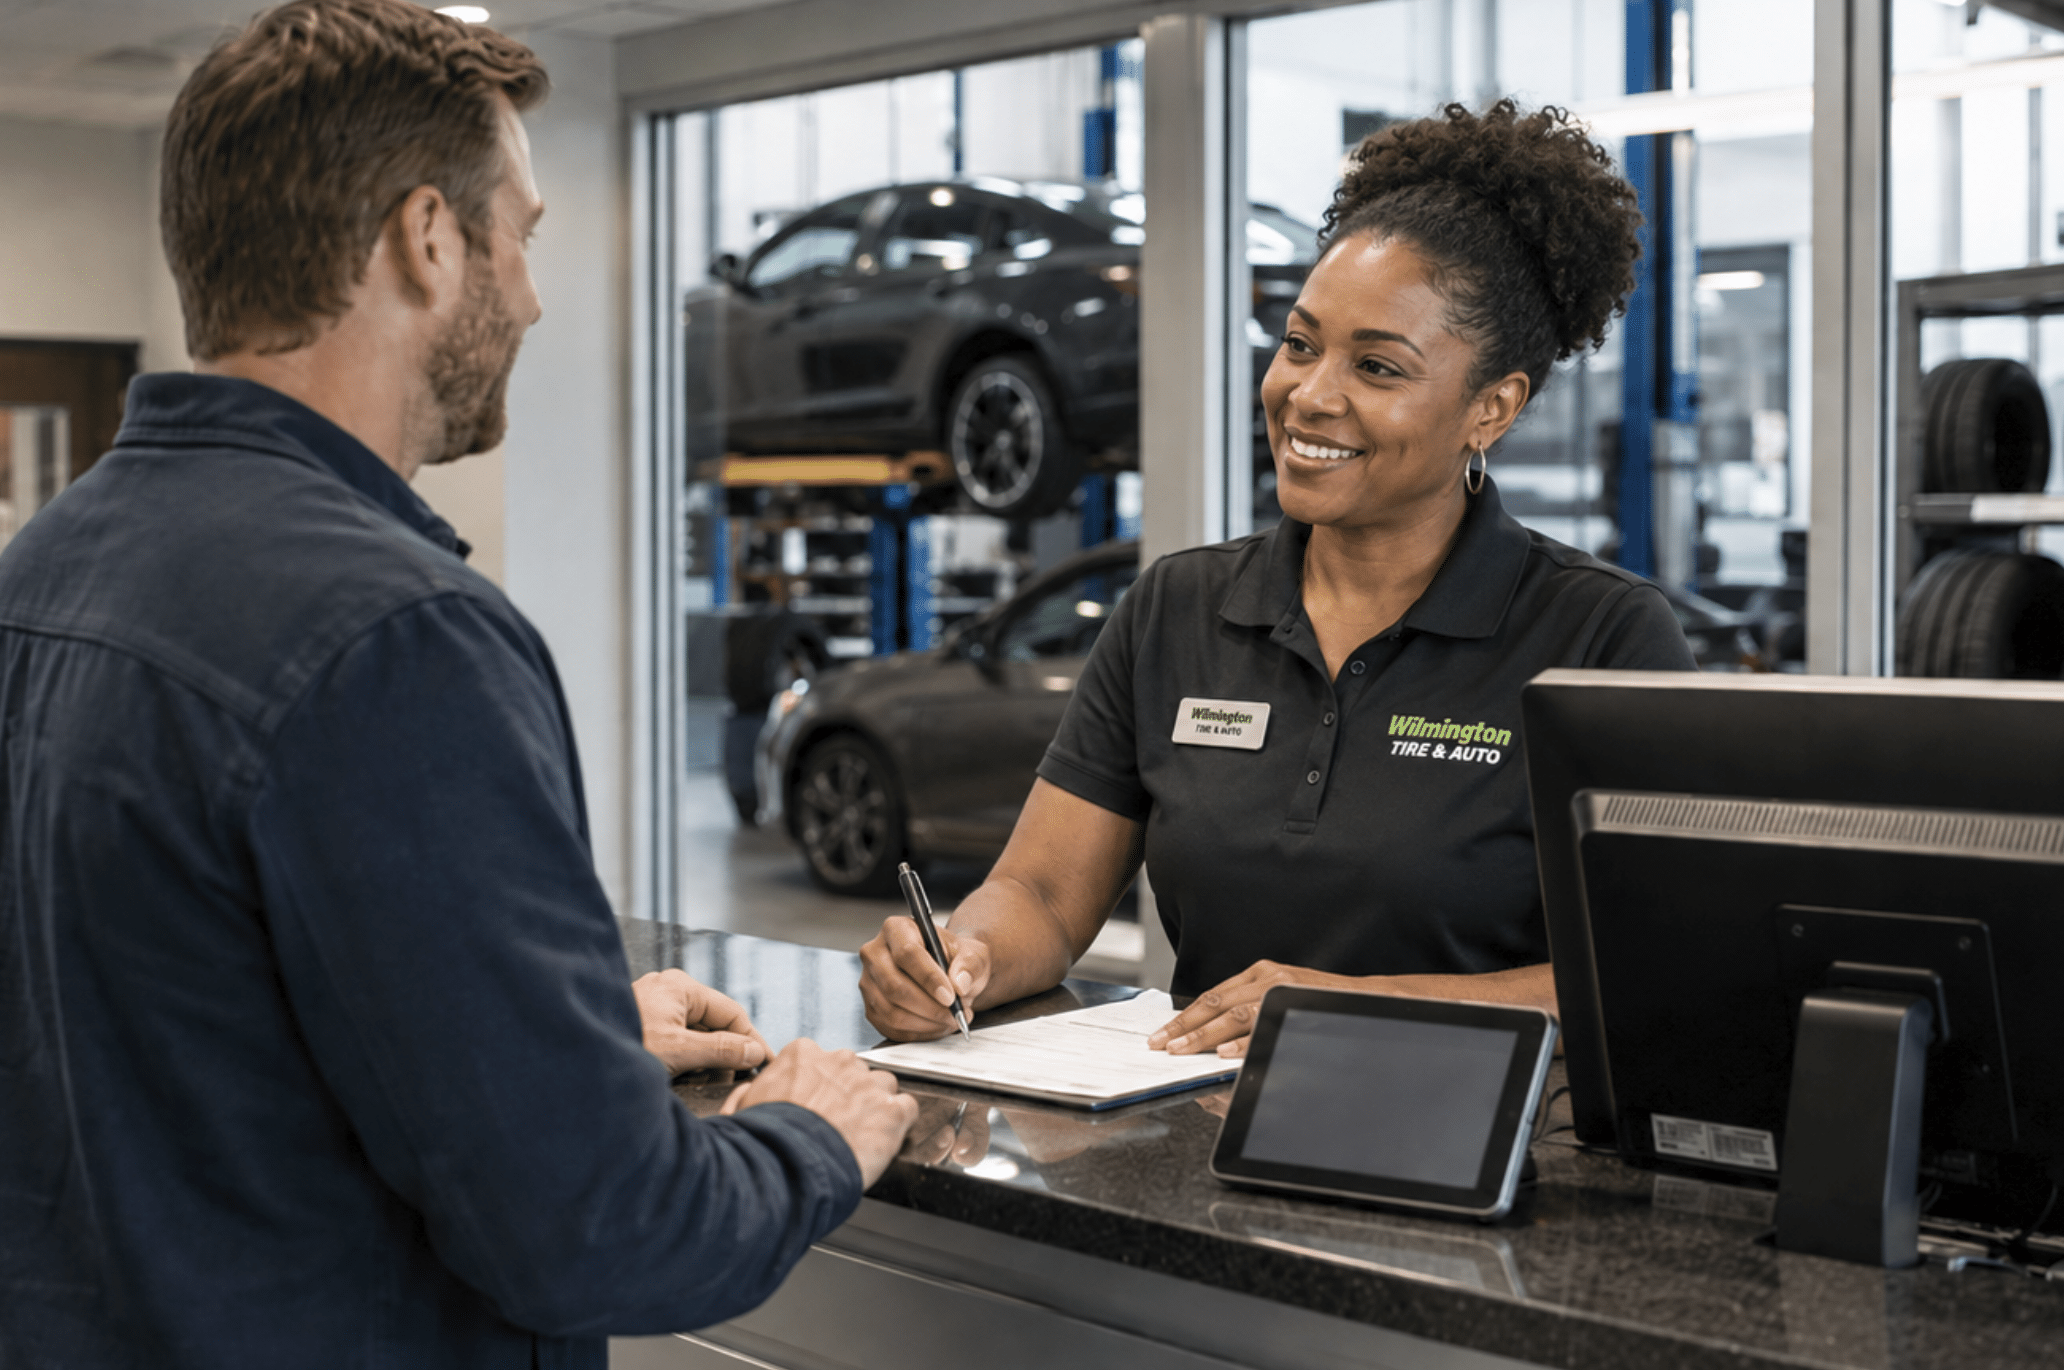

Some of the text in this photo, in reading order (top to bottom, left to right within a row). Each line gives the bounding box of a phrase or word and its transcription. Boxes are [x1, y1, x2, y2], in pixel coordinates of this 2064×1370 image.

[1388, 715, 1512, 745] Wilmington
[1391, 741, 1501, 764] TIRE & AUTO
